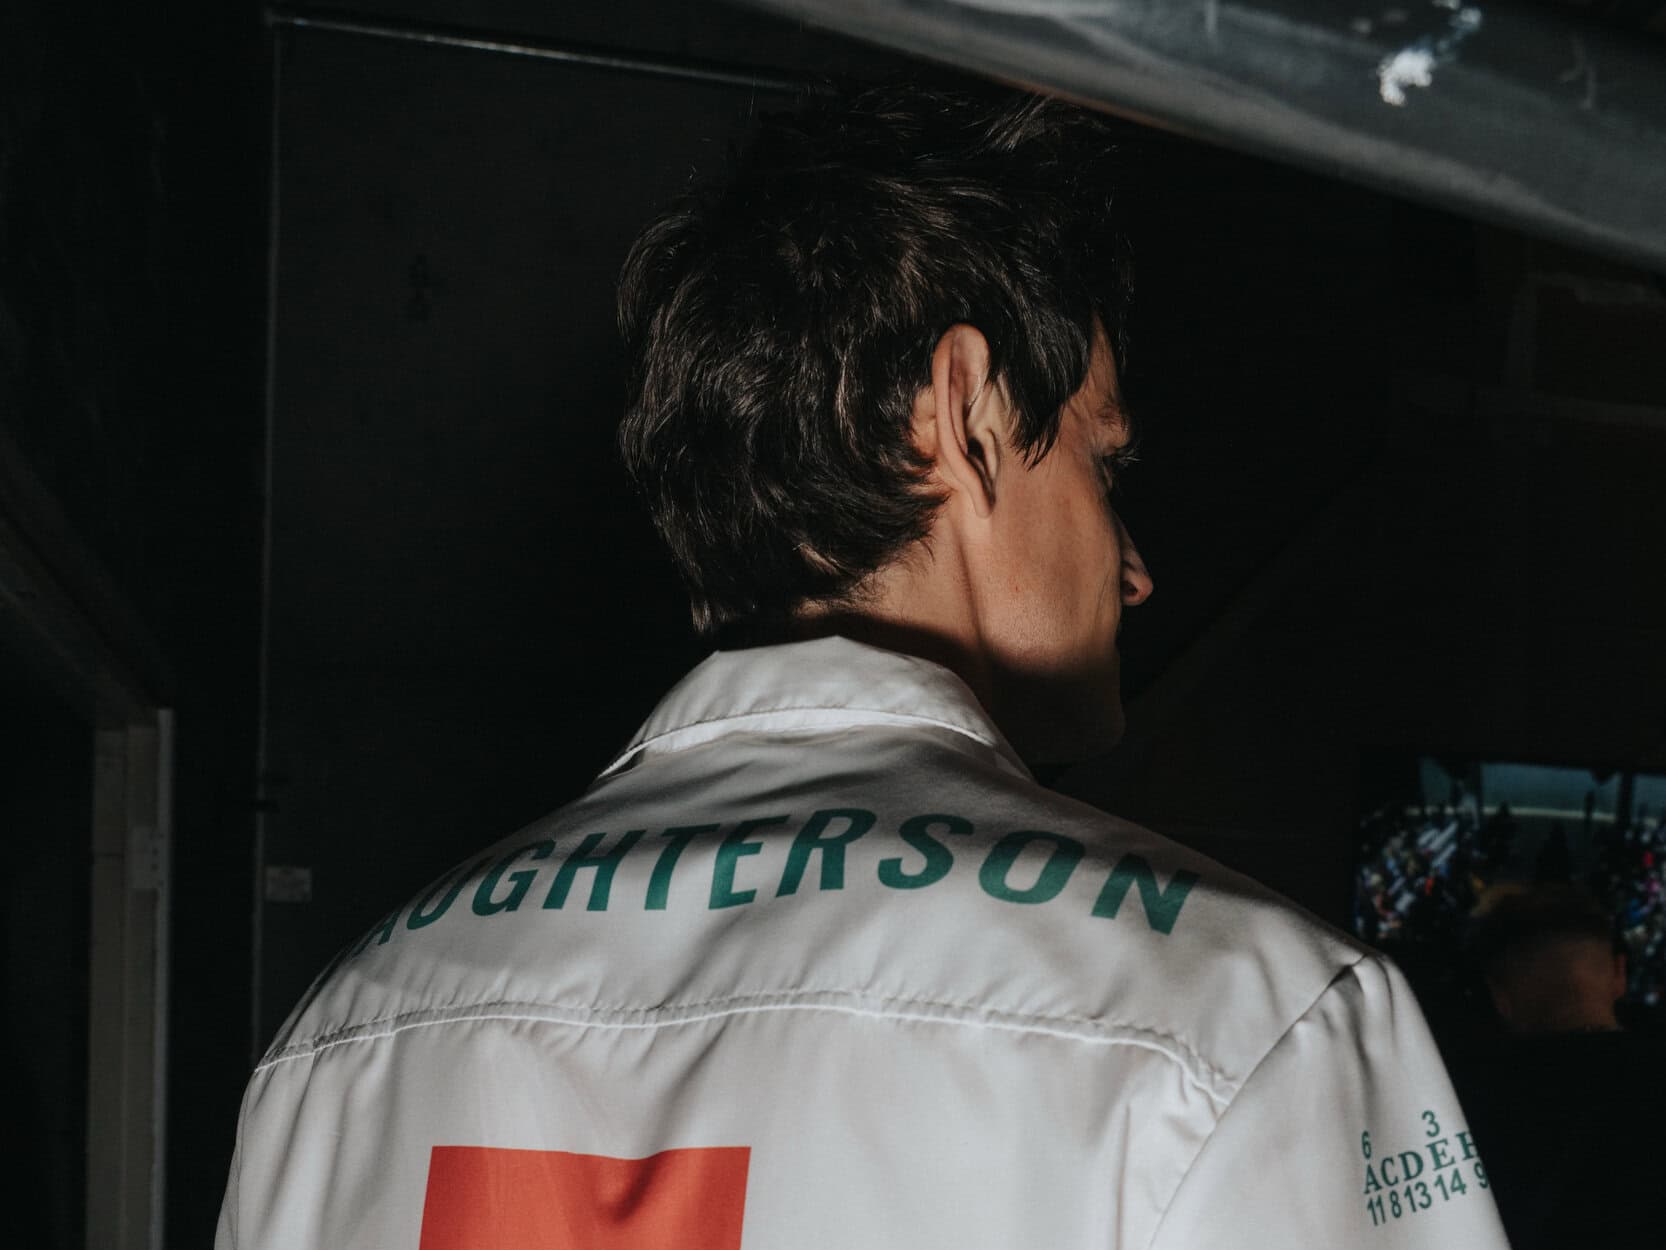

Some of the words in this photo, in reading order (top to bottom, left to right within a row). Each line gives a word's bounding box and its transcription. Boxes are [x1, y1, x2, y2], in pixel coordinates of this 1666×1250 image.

[1361, 1130, 1371, 1158] 6
[1422, 1110, 1440, 1137] 3
[1367, 1195, 1386, 1226] 11
[1390, 1190, 1402, 1219] 8
[1404, 1182, 1432, 1213] 13
[1435, 1168, 1466, 1201] 14
[1474, 1161, 1489, 1189] 9
